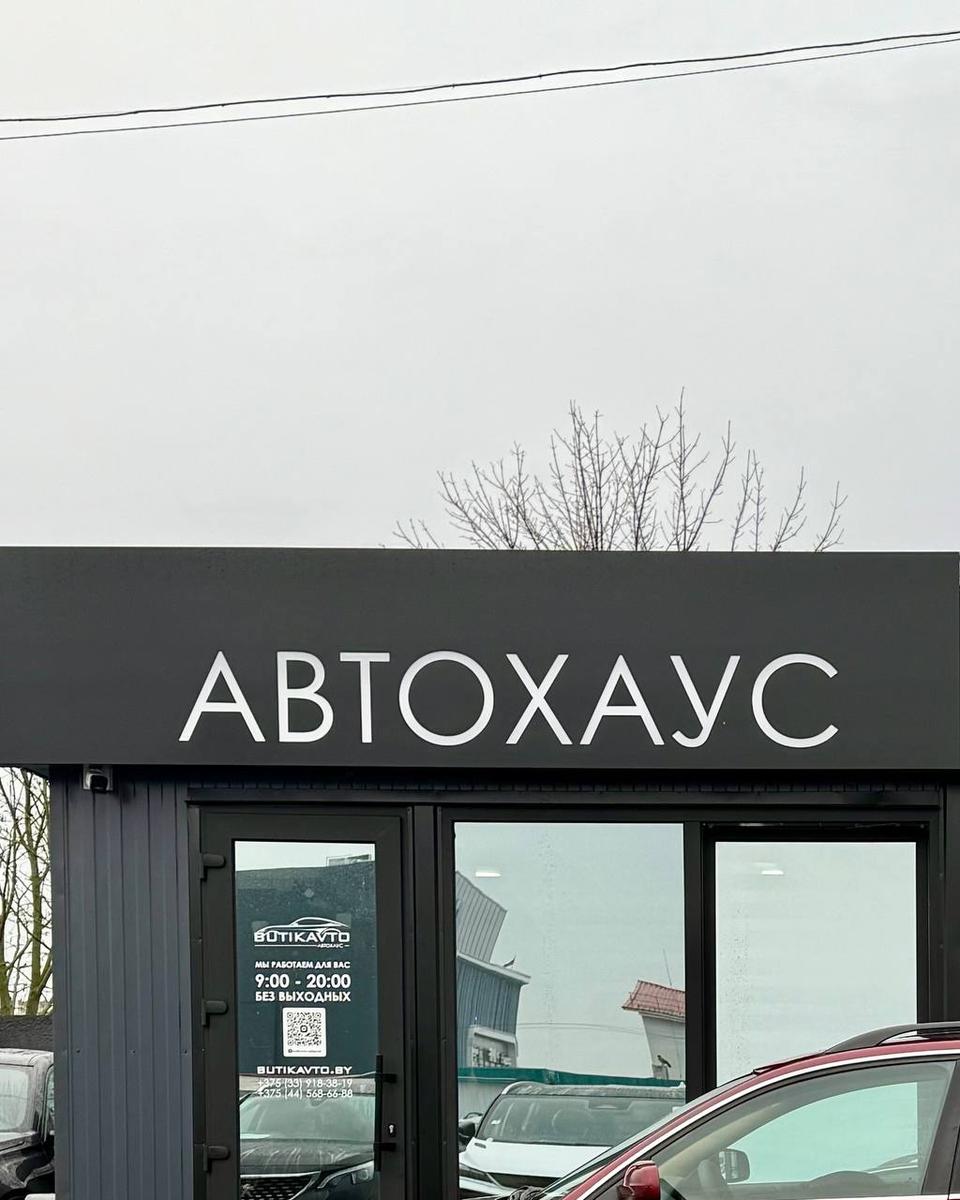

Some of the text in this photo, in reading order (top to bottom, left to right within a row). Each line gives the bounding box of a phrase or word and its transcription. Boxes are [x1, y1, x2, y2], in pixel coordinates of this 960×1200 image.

[179, 651, 839, 748] АВТОХАУС
[254, 932, 350, 942] BUTIKAVTO
[255, 961, 351, 969] МЫ РАБОТАЕМ ДЛЯ ВАС
[255, 974, 290, 988] 9:00
[306, 974, 351, 988] 20:00
[255, 991, 351, 1002] БЕЗ ВЫХОДНЫХ
[257, 1066, 352, 1074] BUTIKAVTO.BY
[284, 1079, 302, 1090] (33)
[306, 1079, 353, 1088] 918-38-19
[258, 1088, 353, 1100] +375 (44) 568-66-88
